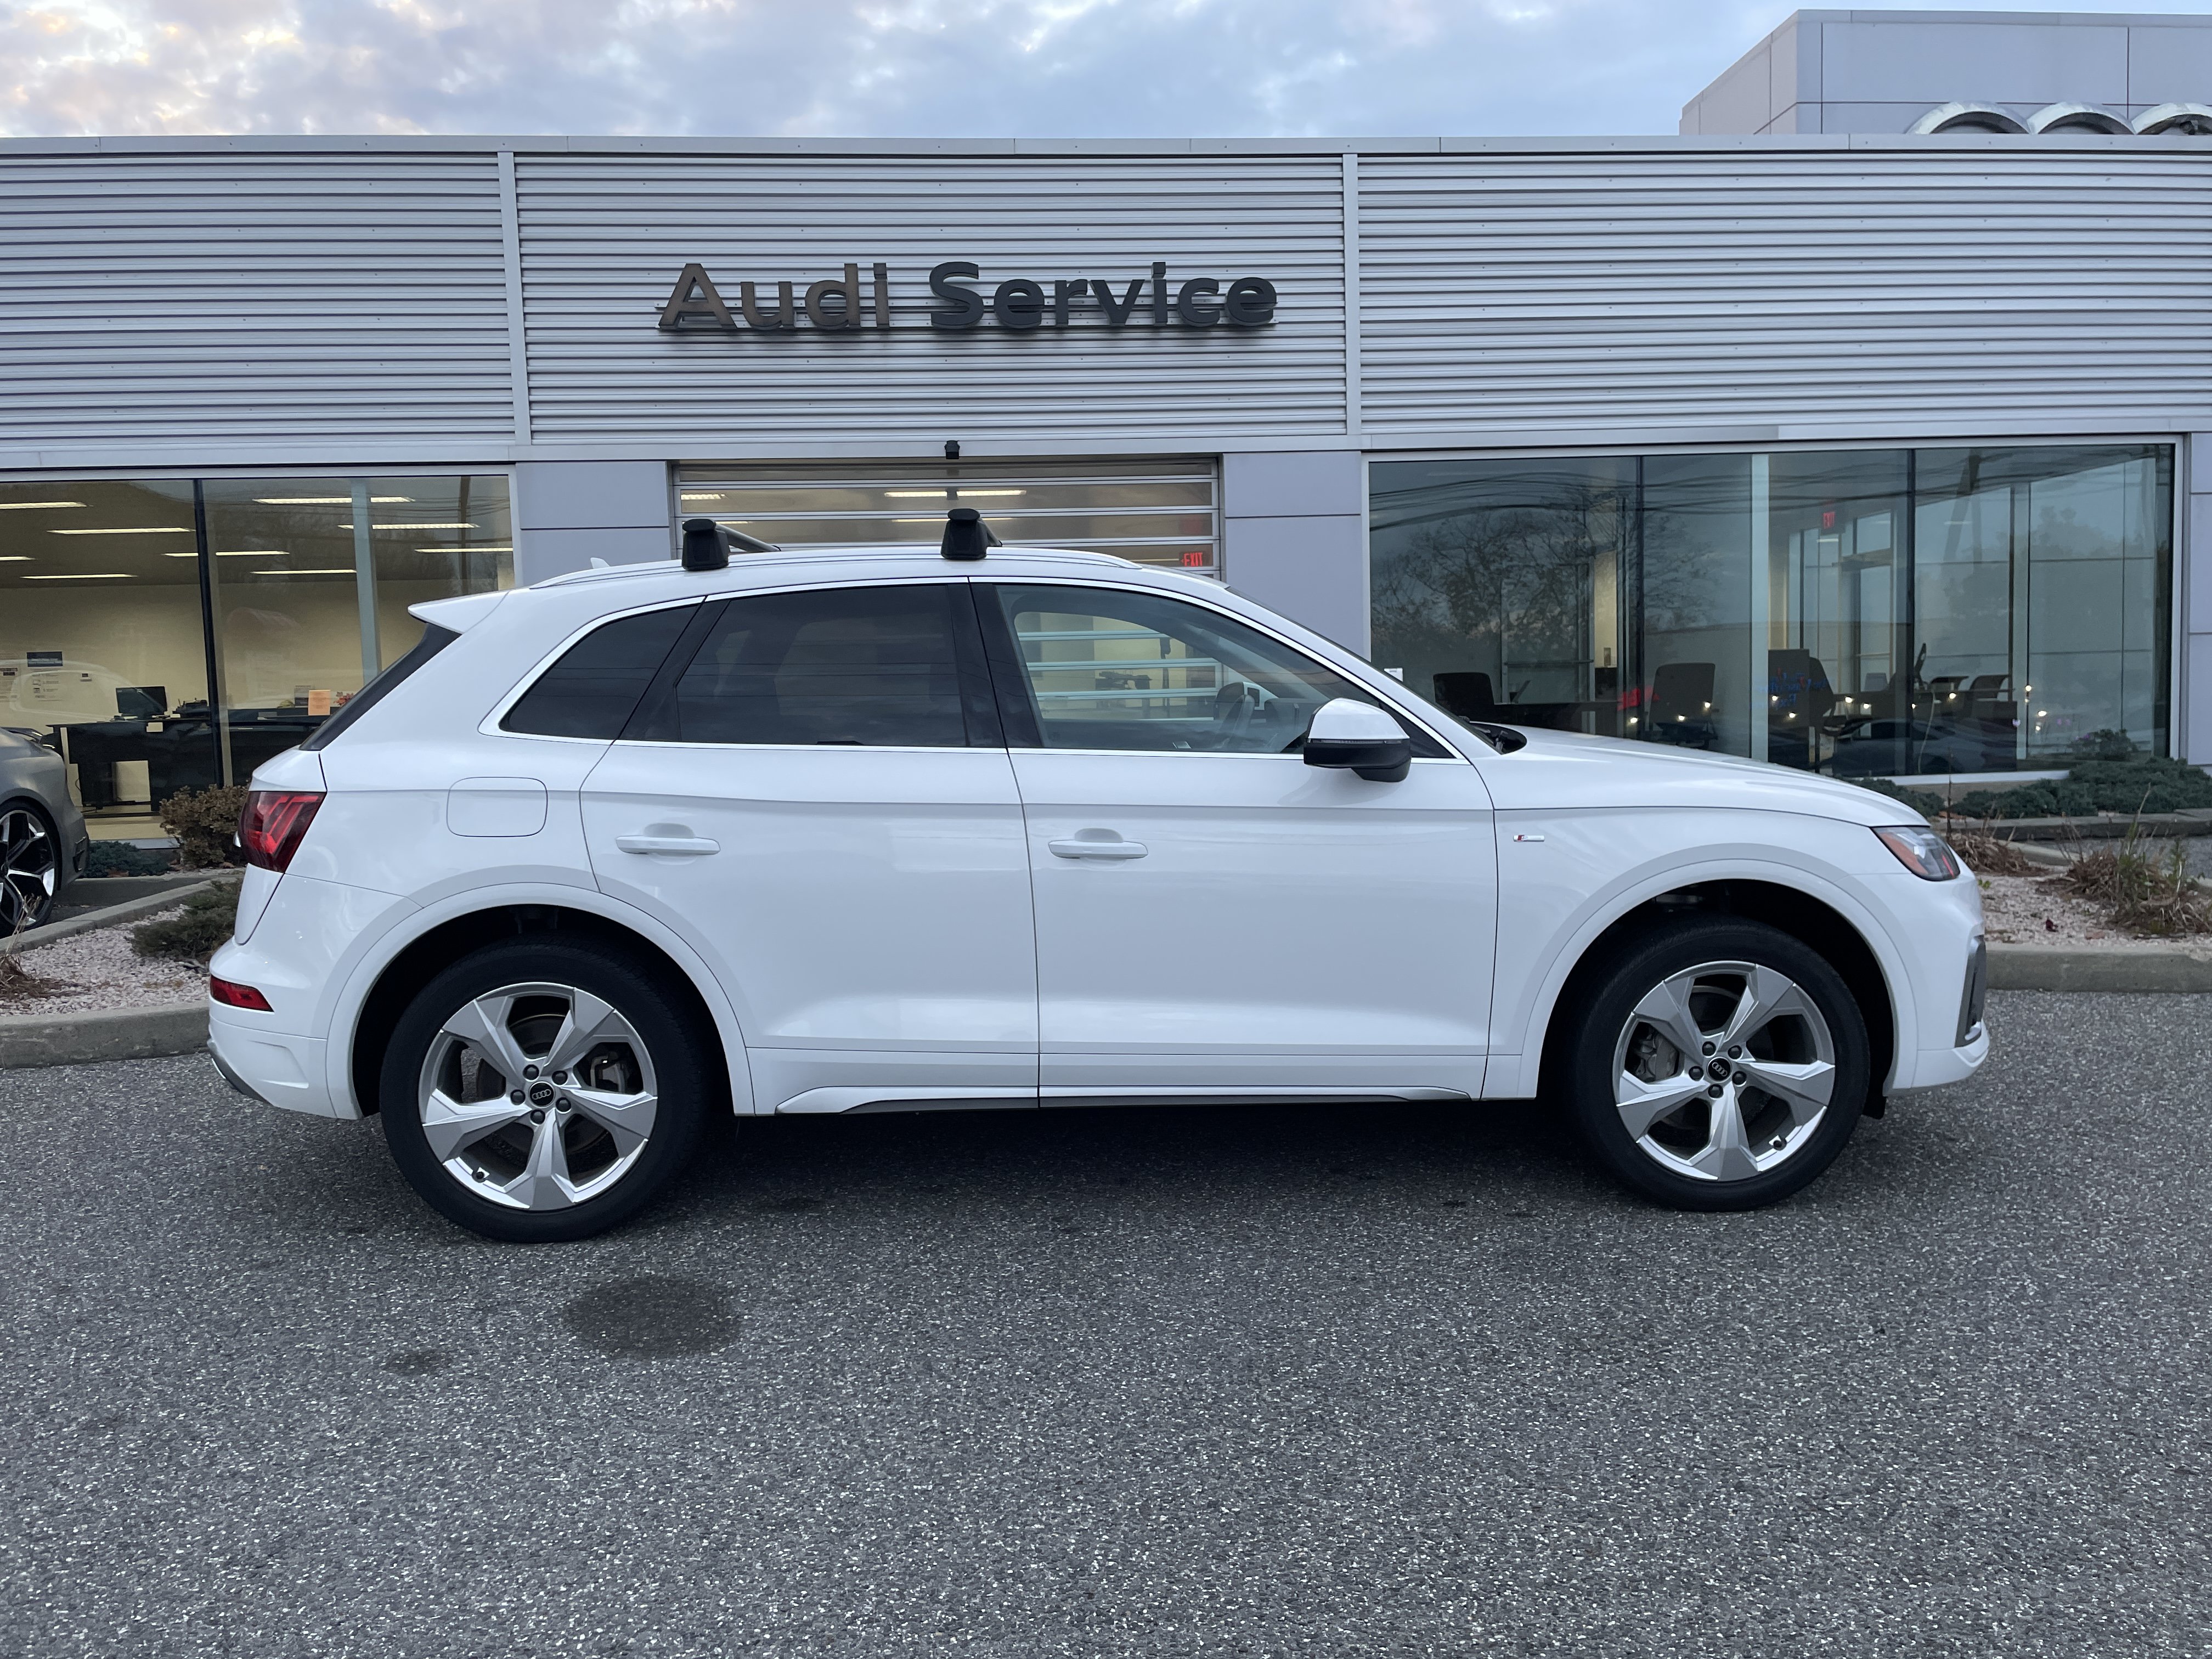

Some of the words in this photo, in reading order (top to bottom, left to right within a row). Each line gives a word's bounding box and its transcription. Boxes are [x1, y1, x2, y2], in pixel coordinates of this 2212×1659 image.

[658, 263, 890, 329] Audi
[929, 261, 1277, 328] Service
[1184, 552, 1203, 567] EXIT
